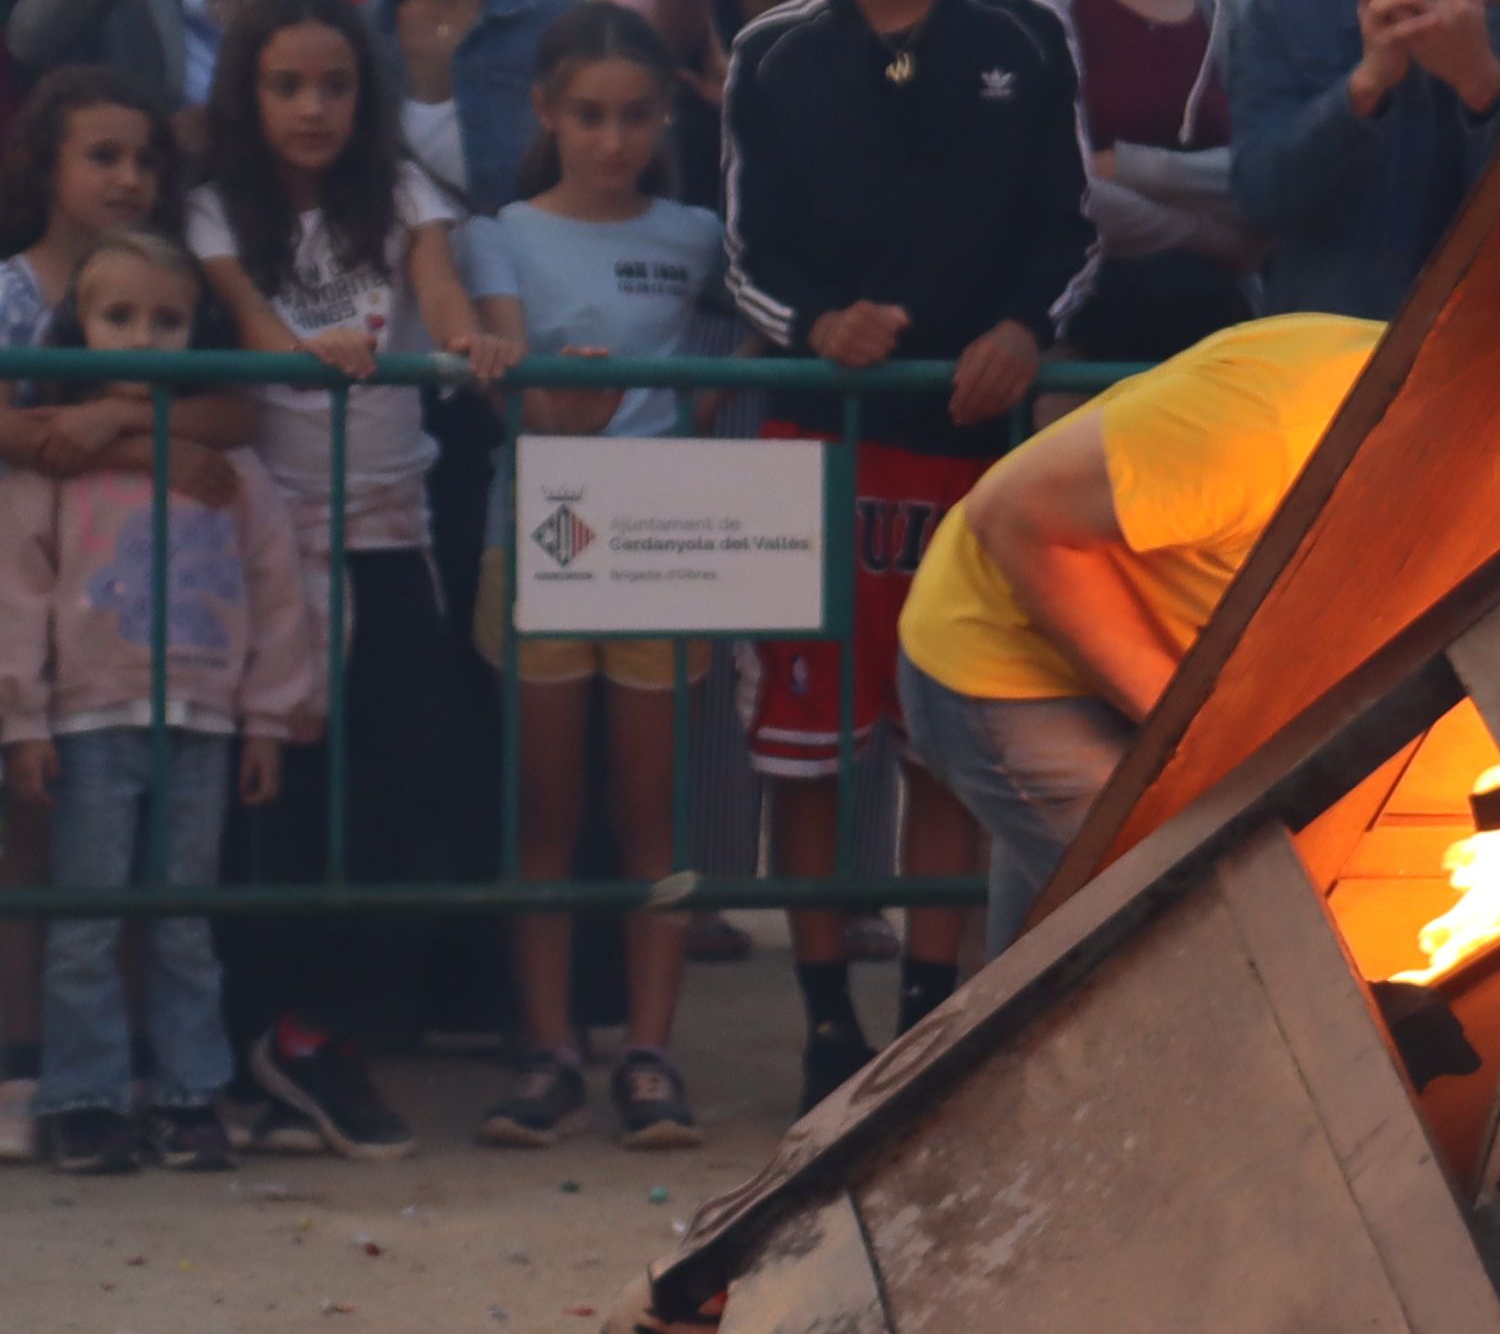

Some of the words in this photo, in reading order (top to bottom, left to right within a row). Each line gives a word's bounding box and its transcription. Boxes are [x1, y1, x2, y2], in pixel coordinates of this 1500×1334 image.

[719, 518, 742, 532] de
[608, 536, 715, 554] Cerdanyola
[720, 536, 750, 551] del
